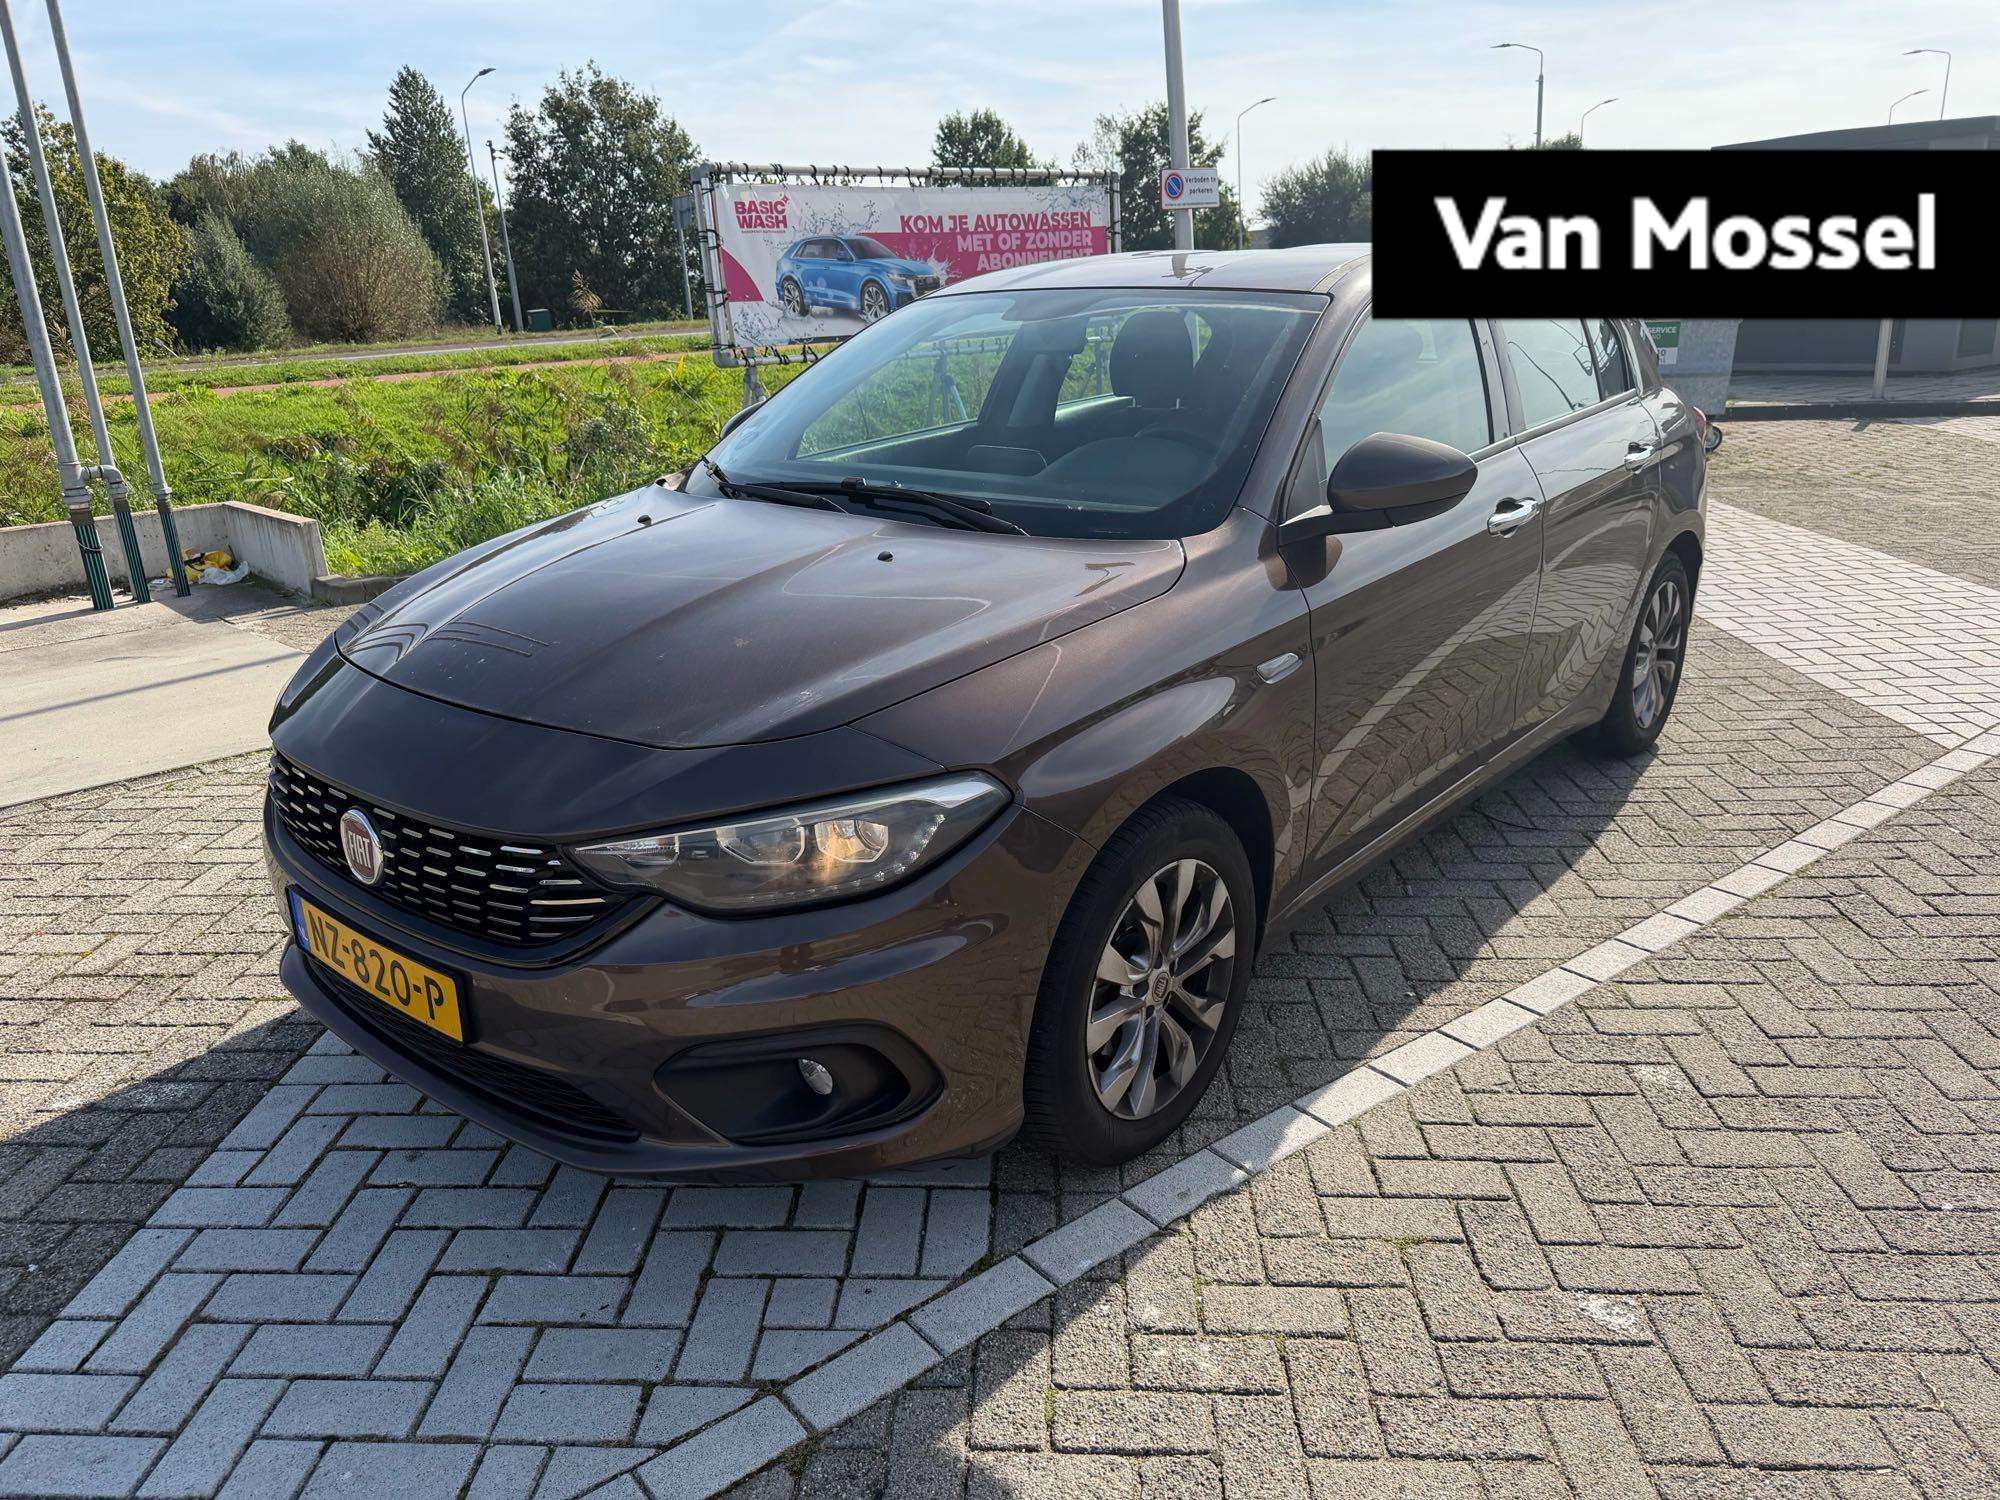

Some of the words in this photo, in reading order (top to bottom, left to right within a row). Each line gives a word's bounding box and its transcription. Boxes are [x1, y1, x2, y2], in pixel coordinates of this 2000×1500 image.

[1189, 187, 1213, 195] parkeren
[734, 200, 786, 215] BASIC
[736, 214, 788, 229] WASH
[900, 214, 943, 233] KOM
[948, 214, 969, 233] JE
[973, 211, 1092, 232] AUTOWASSEN
[957, 233, 993, 252] MET
[997, 232, 1021, 251] OF
[1025, 229, 1093, 250] ZONDER
[347, 830, 371, 869] FIAT
[307, 910, 445, 1020] NZ-820-P
